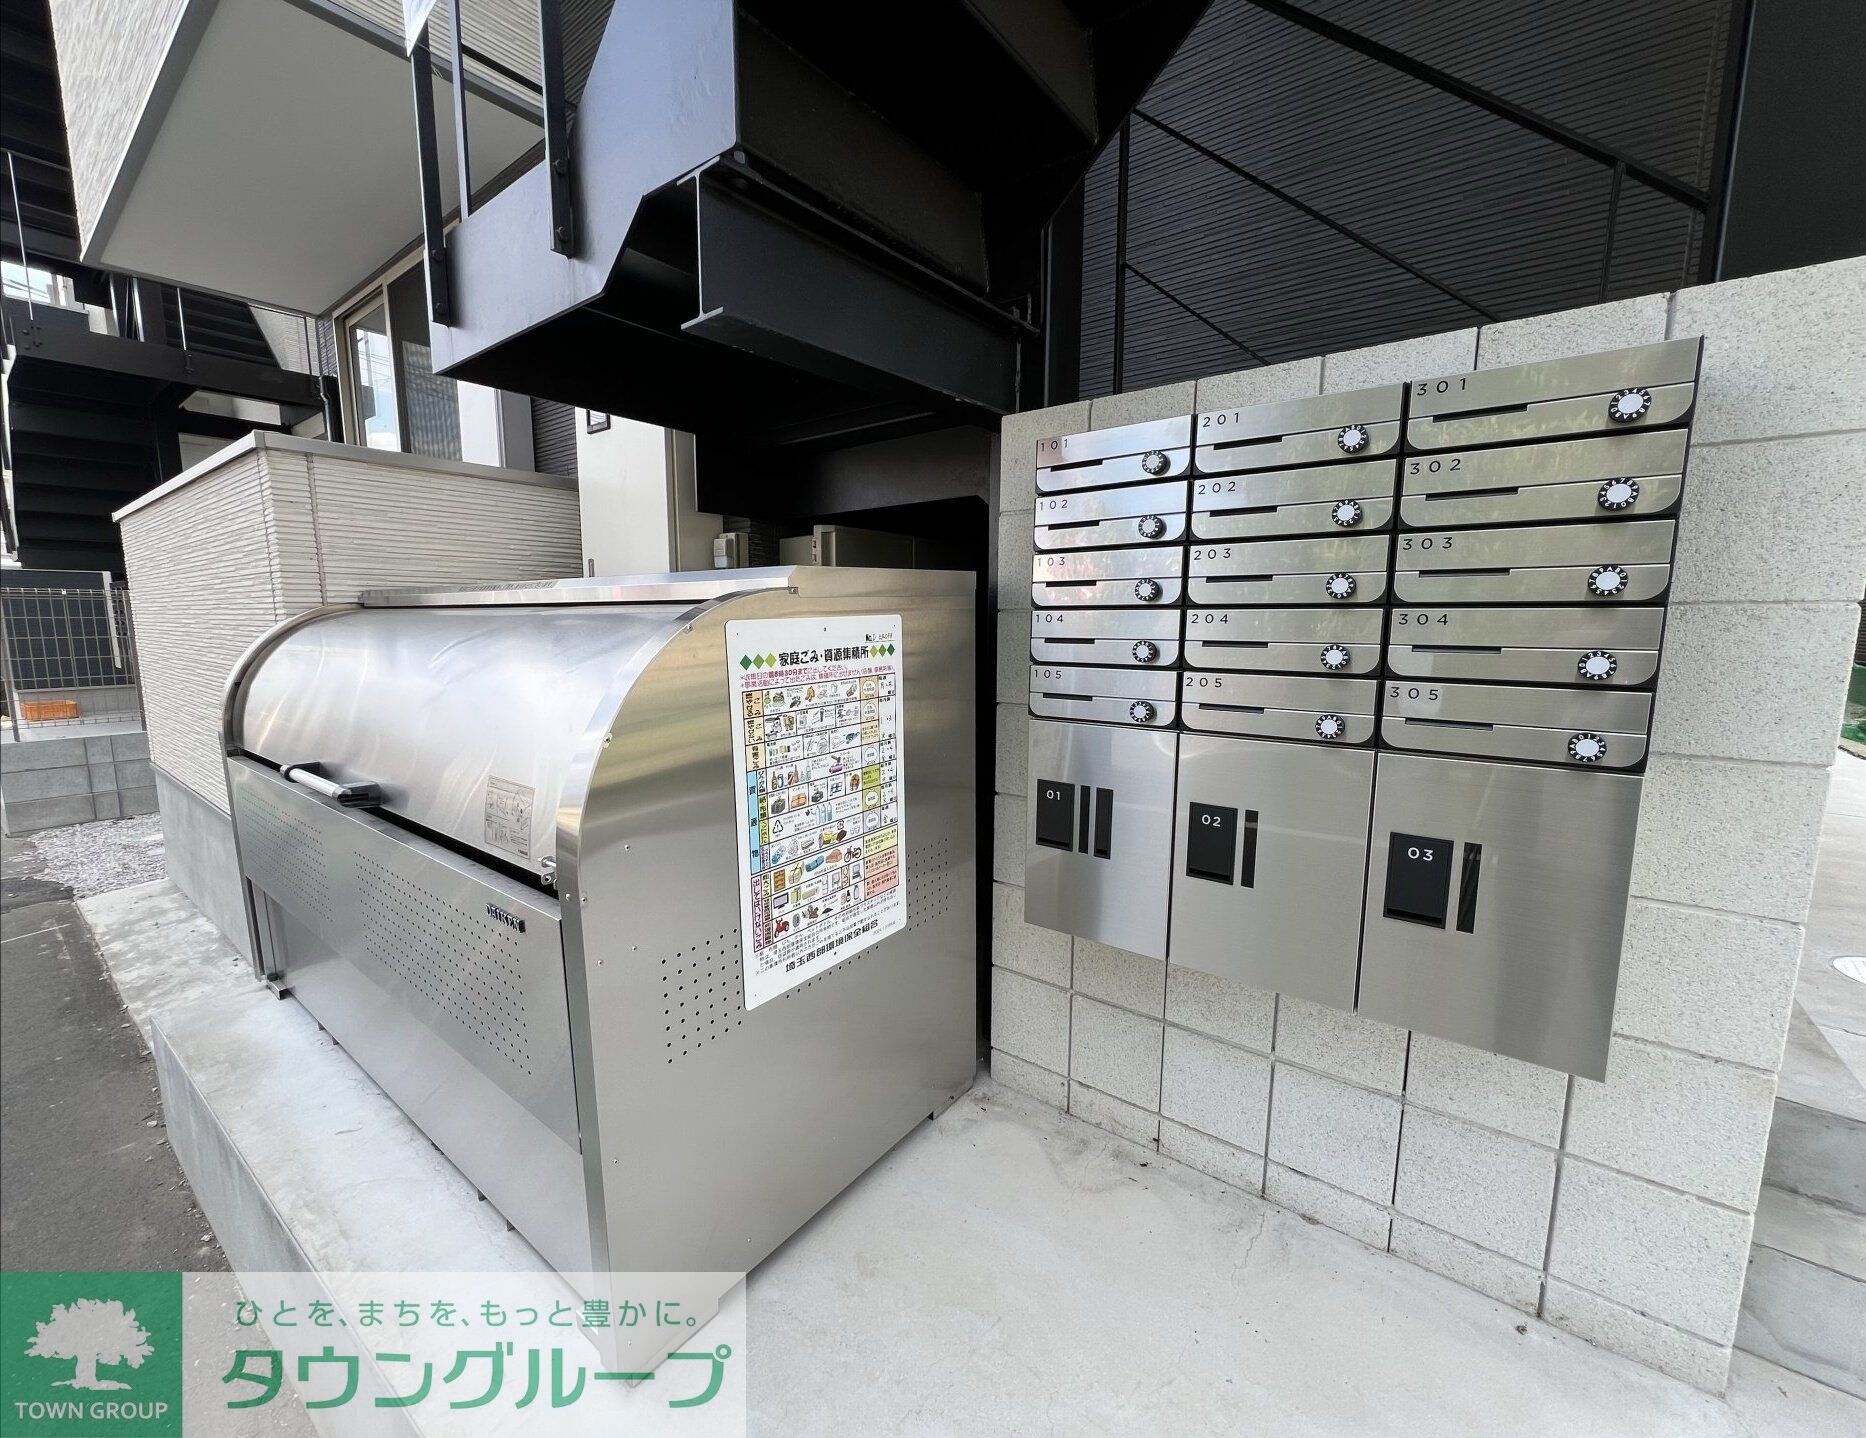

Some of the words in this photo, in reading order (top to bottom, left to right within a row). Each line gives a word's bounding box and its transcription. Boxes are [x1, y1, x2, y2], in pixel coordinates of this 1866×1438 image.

[1417, 378, 1465, 396] 301
[1203, 412, 1239, 427] 201
[1041, 439, 1067, 451] 101
[1410, 459, 1460, 474] 302
[1199, 481, 1235, 494] 202
[1040, 500, 1067, 510] 102
[1403, 537, 1452, 550] 303
[1194, 548, 1231, 560] 203
[1037, 556, 1067, 567] 103
[1036, 614, 1063, 622] 104
[1192, 614, 1228, 624] 204
[1399, 614, 1448, 625] 304
[778, 644, 869, 667] 家庭ごみ・資源集積所
[1035, 670, 1061, 679] 105
[1186, 677, 1221, 687] 205
[1390, 687, 1438, 700] 305
[1046, 789, 1061, 801] 01
[1201, 813, 1221, 827] 02
[1407, 846, 1434, 862] 03
[784, 917, 878, 973] 埼玉西部環境保全組合
